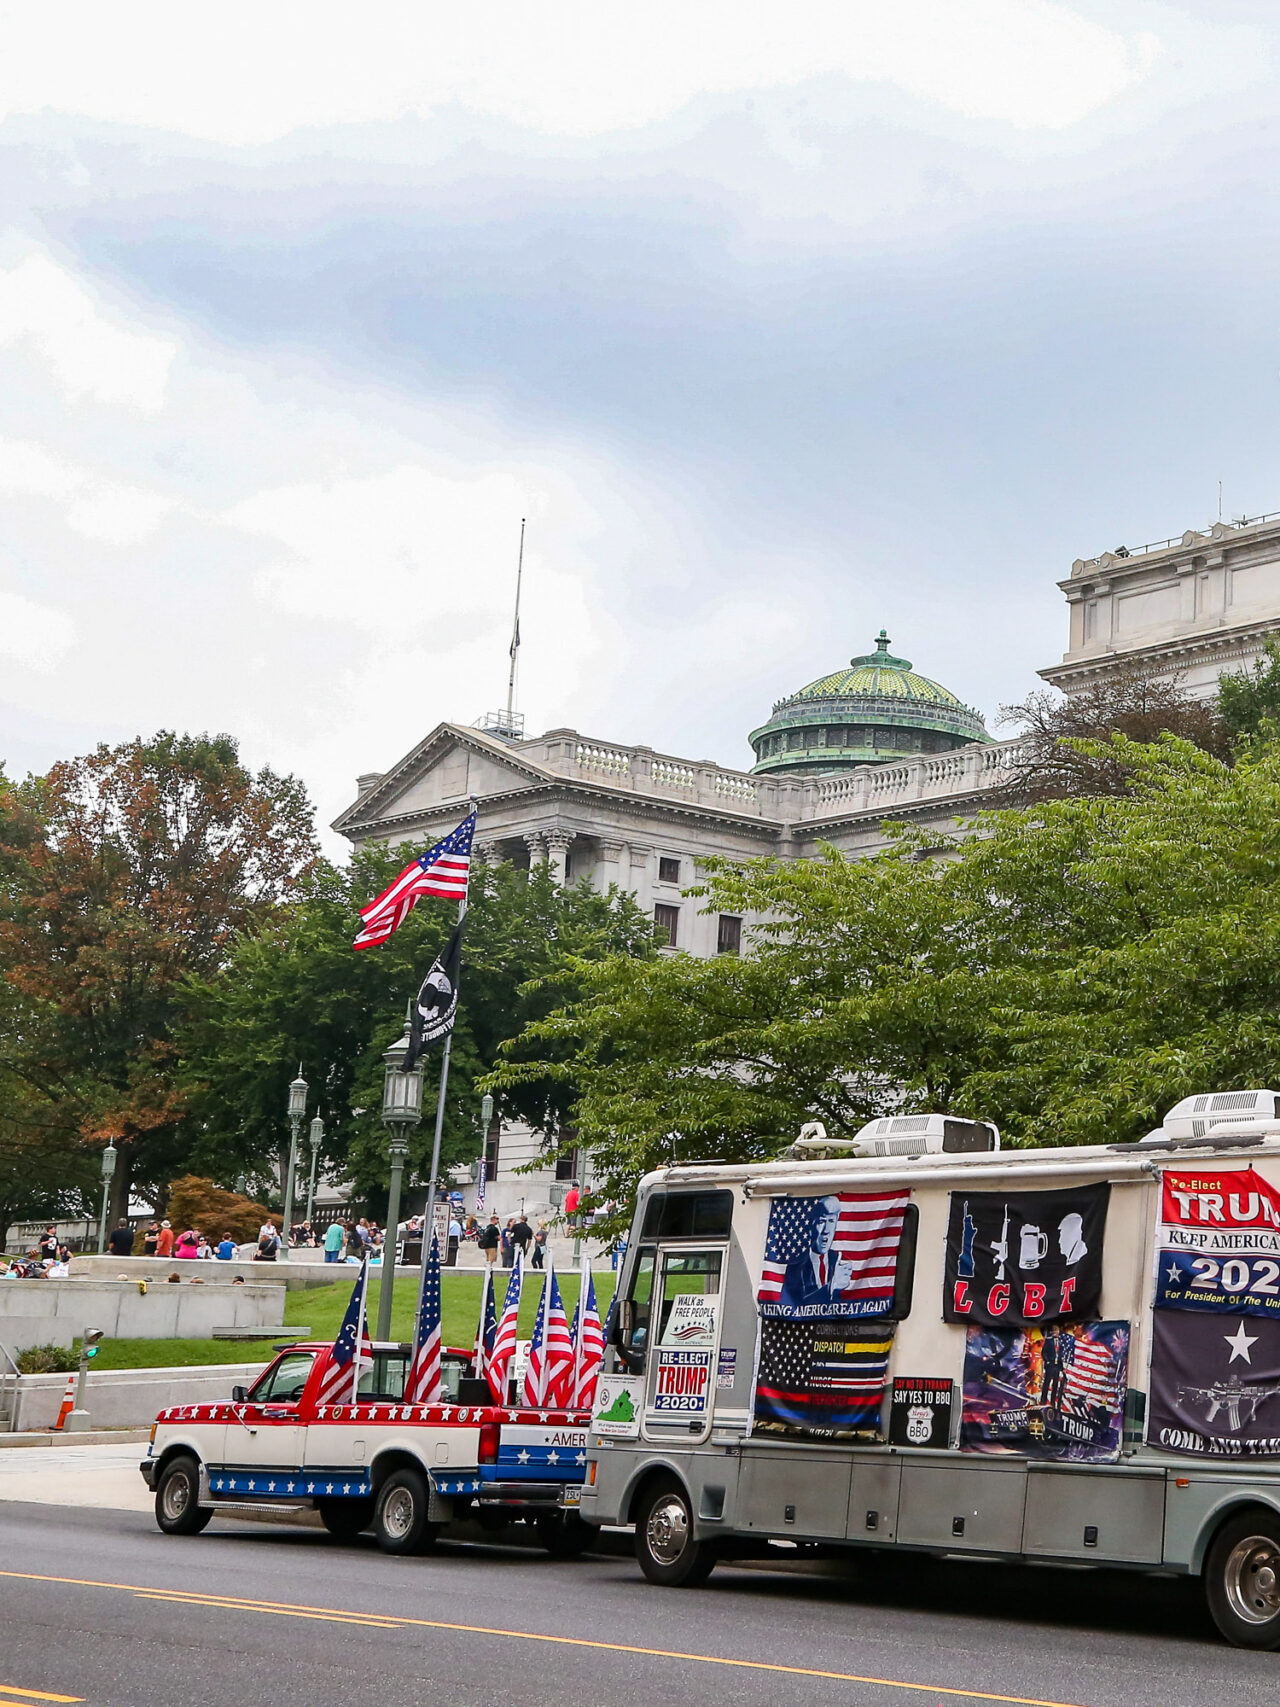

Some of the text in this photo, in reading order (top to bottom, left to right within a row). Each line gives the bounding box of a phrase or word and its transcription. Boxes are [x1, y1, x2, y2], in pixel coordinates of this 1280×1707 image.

[1170, 1178, 1222, 1190] Re-Elect
[1168, 1230, 1280, 1250] KEEP AMERICA
[677, 1296, 704, 1307] WALK as
[1165, 1290, 1180, 1299] For
[1184, 1290, 1226, 1304] President
[1229, 1294, 1240, 1304] Of
[1243, 1295, 1261, 1306] The
[674, 1307, 716, 1318] FREE PEOPLE
[759, 1303, 791, 1316] AKING
[813, 1341, 844, 1353] DISPATCH
[661, 1352, 707, 1364] RE-ELECT
[658, 1366, 708, 1395] TRUMP
[660, 1396, 698, 1409] 2020
[894, 1390, 951, 1405] SAY YES TO BBQ
[997, 1411, 1028, 1422] TRUMP
[909, 1426, 929, 1438] BBQ
[1062, 1415, 1094, 1441] TRUMP
[551, 1432, 586, 1446] AMER
[1159, 1427, 1204, 1452] COME
[1208, 1436, 1243, 1455] AND
